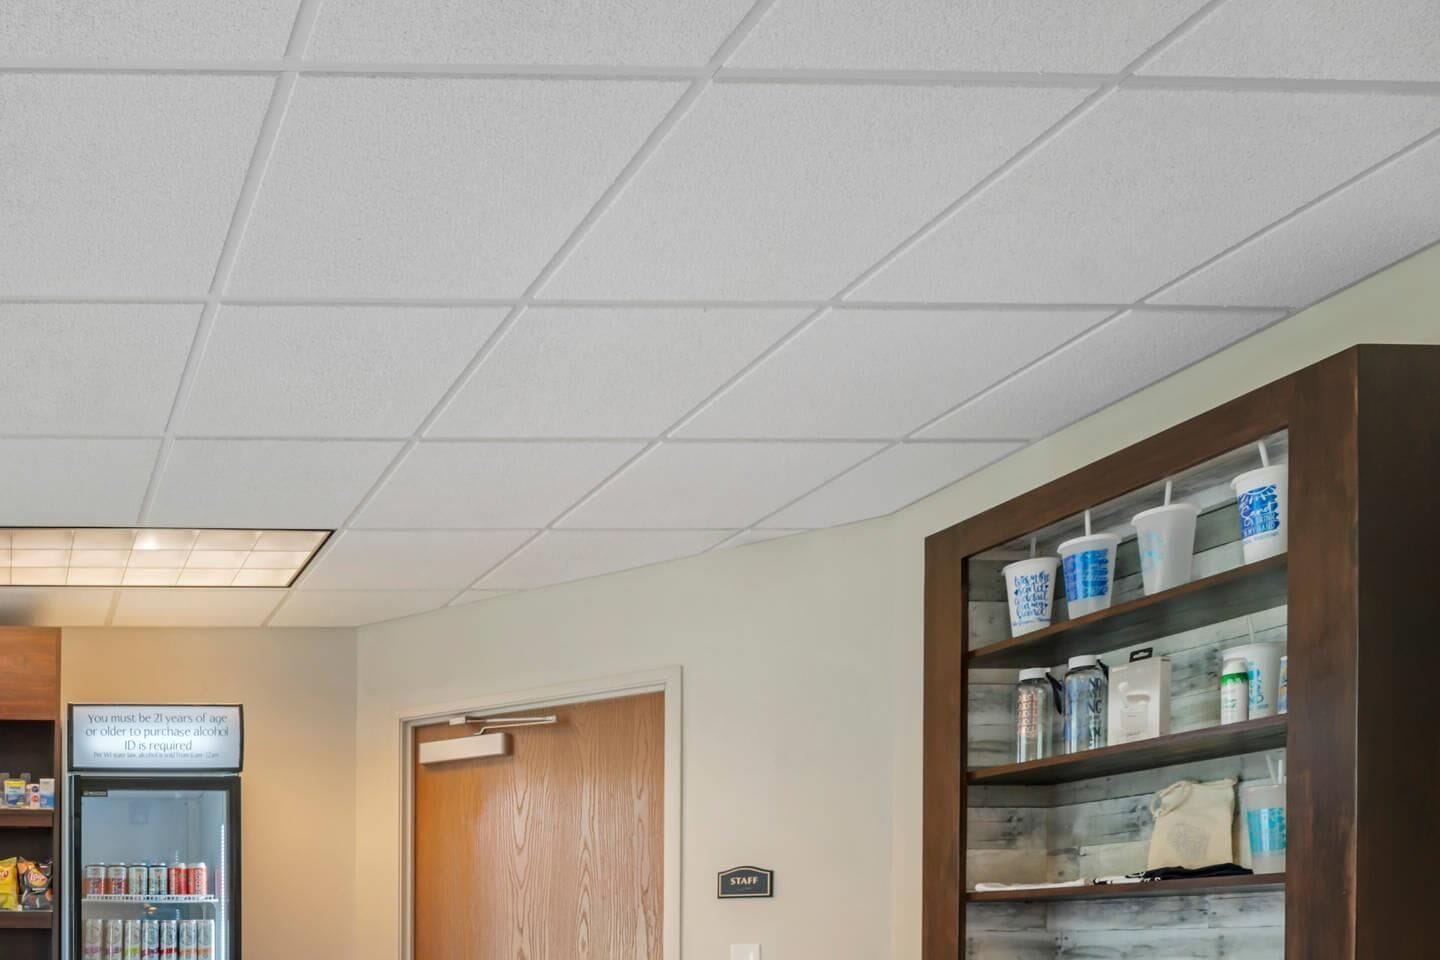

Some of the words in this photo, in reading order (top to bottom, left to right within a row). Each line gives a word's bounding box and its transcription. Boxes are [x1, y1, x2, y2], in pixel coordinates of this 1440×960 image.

[88, 713, 108, 723] You
[111, 714, 135, 723] must
[138, 713, 152, 723] be
[153, 713, 163, 723] 21
[165, 714, 192, 725] years
[196, 713, 207, 723] of
[209, 715, 228, 725] age
[85, 728, 97, 737] or
[100, 726, 126, 737] older
[129, 727, 141, 737] to
[143, 726, 191, 739] purchase
[193, 726, 229, 737] alcohol
[124, 740, 136, 751] ID
[139, 740, 147, 751] is
[148, 739, 193, 752] required
[730, 876, 758, 886] STAFF
